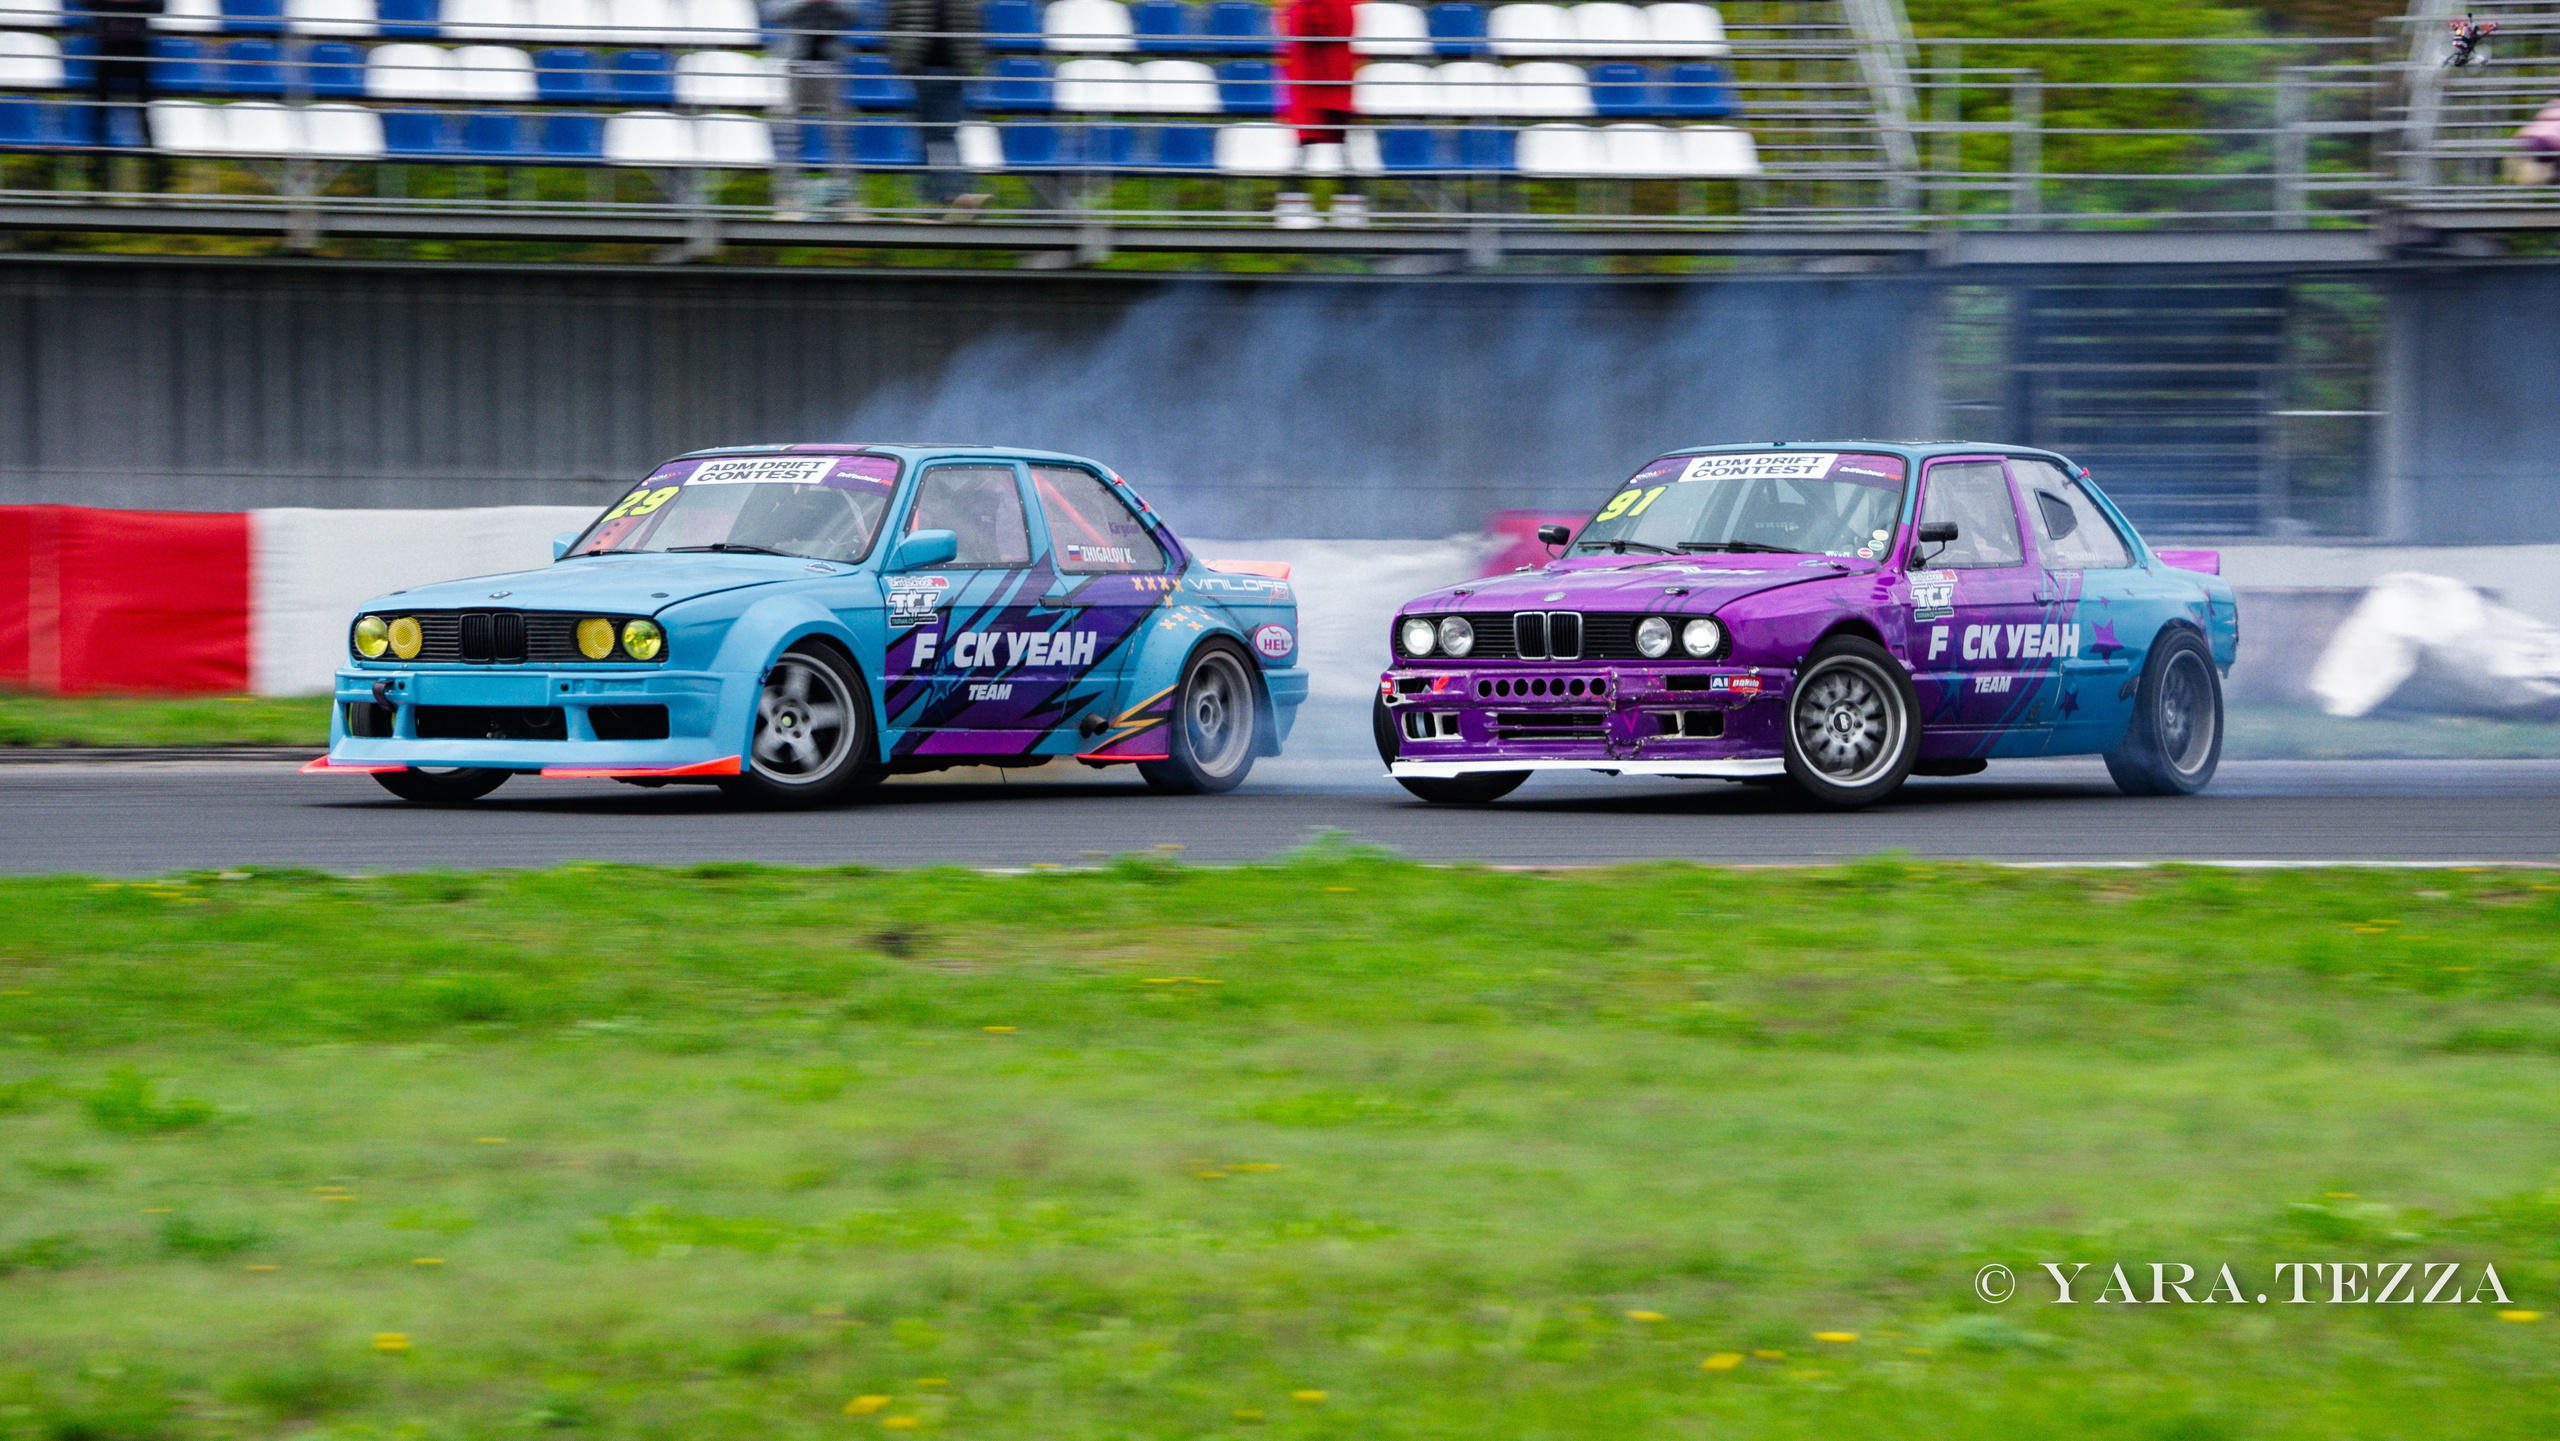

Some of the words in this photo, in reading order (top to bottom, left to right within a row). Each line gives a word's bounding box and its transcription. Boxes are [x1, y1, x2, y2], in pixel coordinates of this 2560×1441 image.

[705, 462, 758, 472] ADM
[759, 461, 827, 470] DRIFT
[1698, 457, 1752, 468] ADM
[1755, 456, 1825, 465] DRIFT
[697, 470, 818, 482] CONTEST
[1691, 465, 1819, 478] CONTEST
[600, 486, 680, 524] 29
[1596, 486, 1667, 523] 91
[1080, 546, 1125, 564] ZHIGALOV
[1123, 547, 1137, 564] K.
[1006, 631, 1097, 667] YEAH
[1263, 638, 1288, 651] HEL
[2006, 623, 2080, 658] YEAH
[968, 684, 1013, 701] TEAM
[1974, 675, 2012, 694] TEAM
